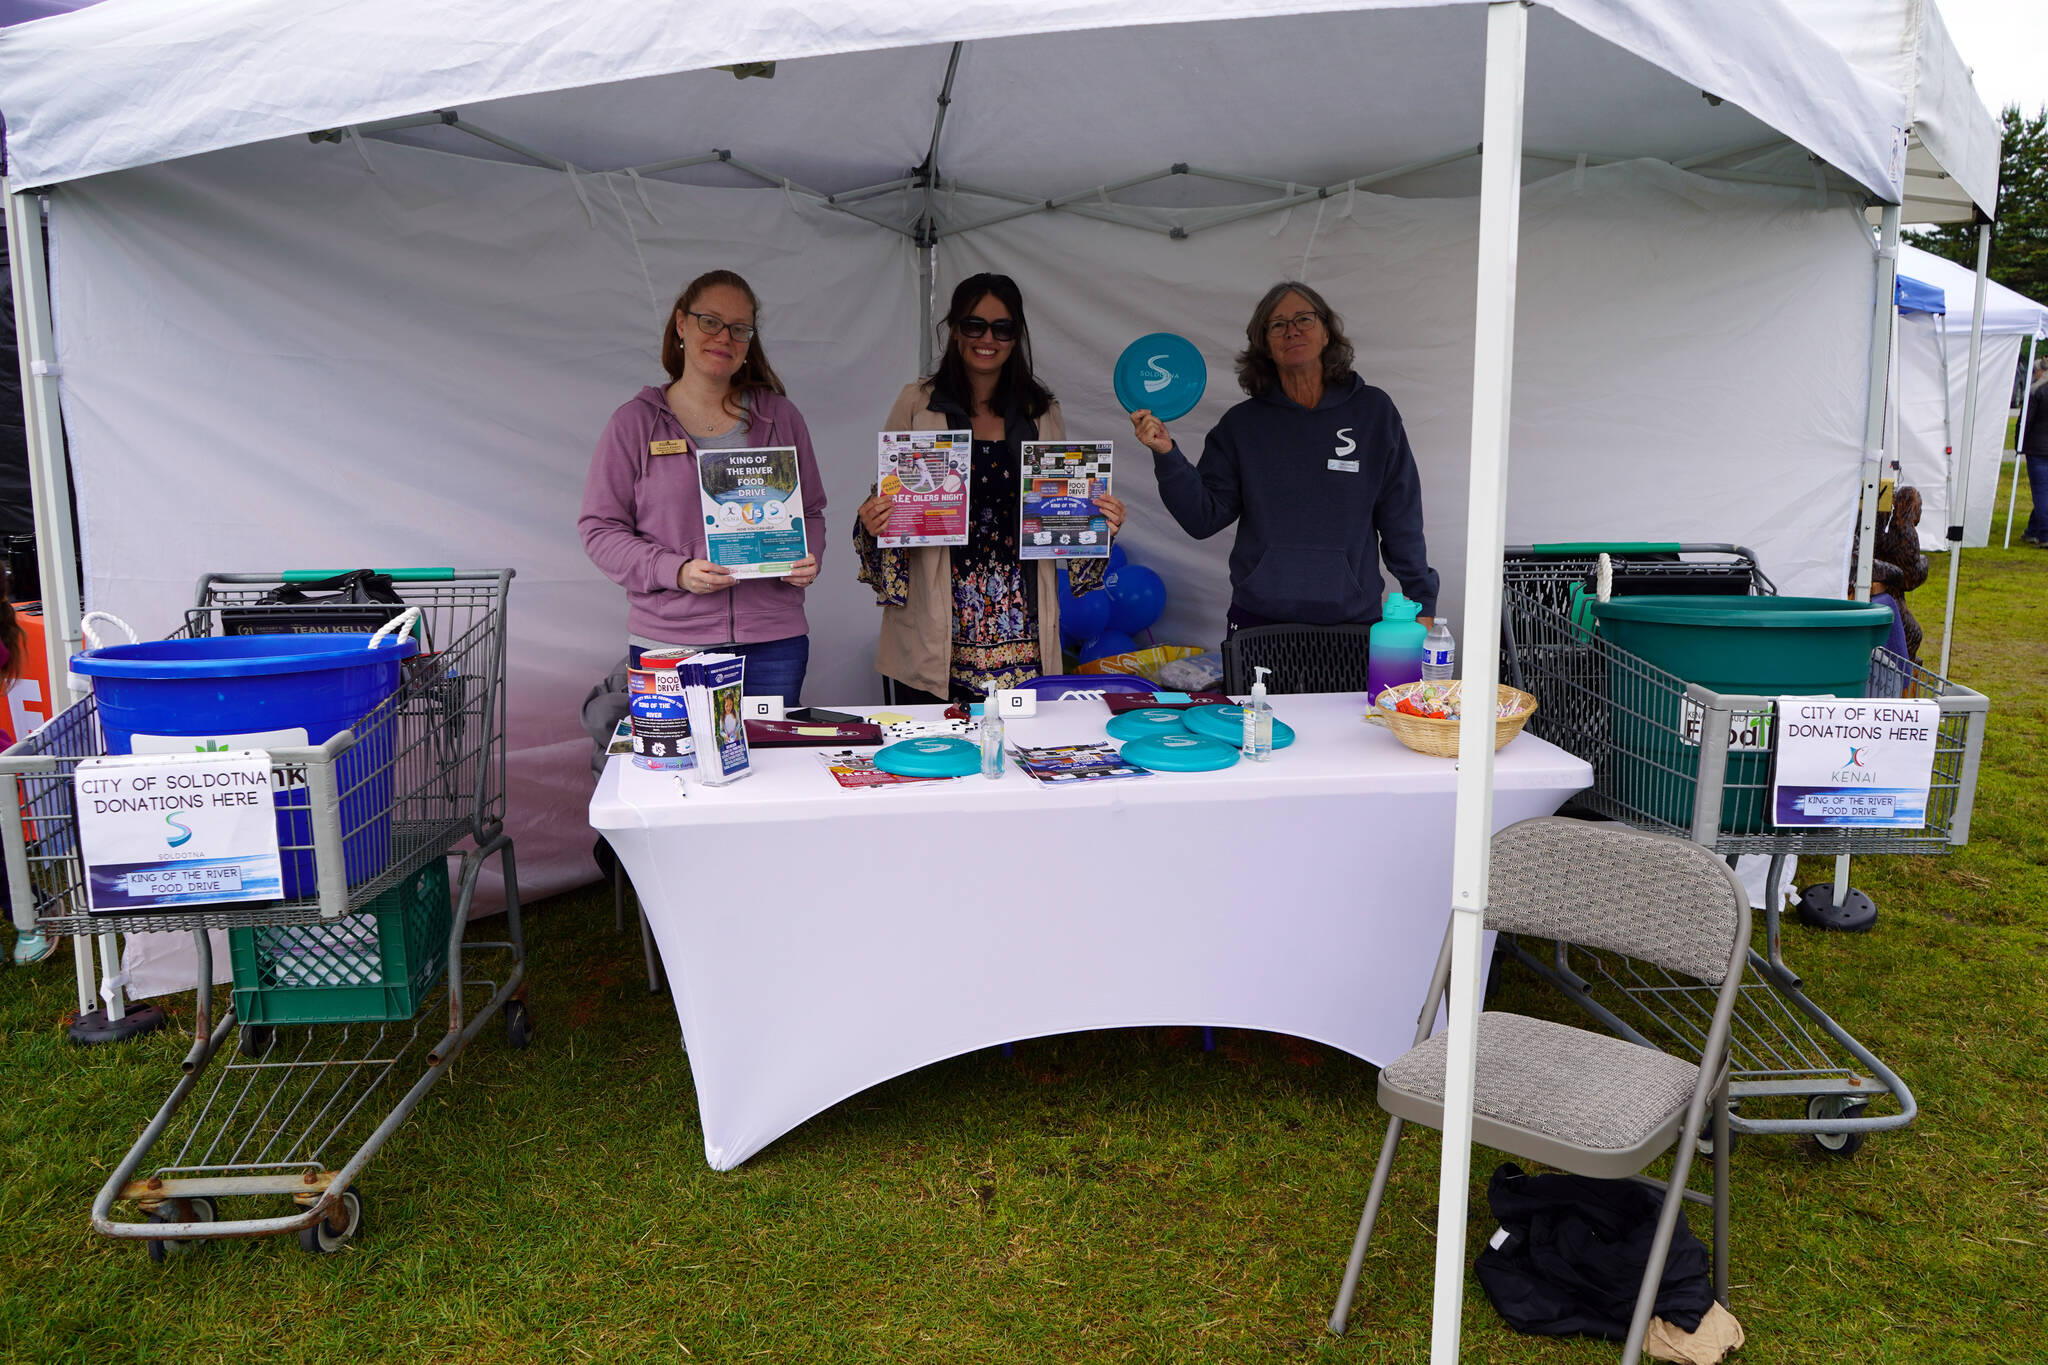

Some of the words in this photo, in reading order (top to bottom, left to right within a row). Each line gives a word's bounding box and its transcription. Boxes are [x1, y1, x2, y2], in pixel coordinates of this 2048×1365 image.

[729, 456, 754, 465] KING
[754, 455, 768, 464] OF
[726, 467, 745, 476] THE
[745, 466, 773, 475] RIVER
[737, 477, 765, 486] FOOD
[738, 488, 766, 497] DRIVE
[912, 494, 939, 502] OILERS
[941, 493, 964, 501] NIGHT
[292, 626, 329, 634] TEAM
[333, 625, 373, 634] KELLY
[657, 676, 680, 684] FOOD
[1801, 706, 1836, 720] CITY
[1844, 707, 1867, 720] OF
[1873, 708, 1919, 722] KENAI
[1788, 724, 1882, 740] DONATIONS
[1889, 728, 1929, 741] HERE
[1831, 771, 1877, 783] KENAI
[81, 778, 122, 794] CITY
[132, 777, 157, 791] OF
[166, 771, 267, 790] SOLDOTNA
[94, 794, 204, 813] DONATIONS
[213, 791, 259, 807] HERE
[1808, 796, 1829, 805] KING
[1832, 796, 1846, 805] OF
[1848, 797, 1865, 805] THE
[1867, 797, 1893, 806] RIVER
[1822, 807, 1848, 815] FOOD
[1851, 807, 1877, 816] DRIVE
[158, 851, 205, 860] SOLDOTNA
[131, 872, 157, 883] KING
[162, 872, 177, 881] OF
[183, 871, 201, 880] THE
[206, 868, 238, 879] RIVER
[151, 883, 186, 893] FOOD
[188, 882, 221, 892] DRIVE
